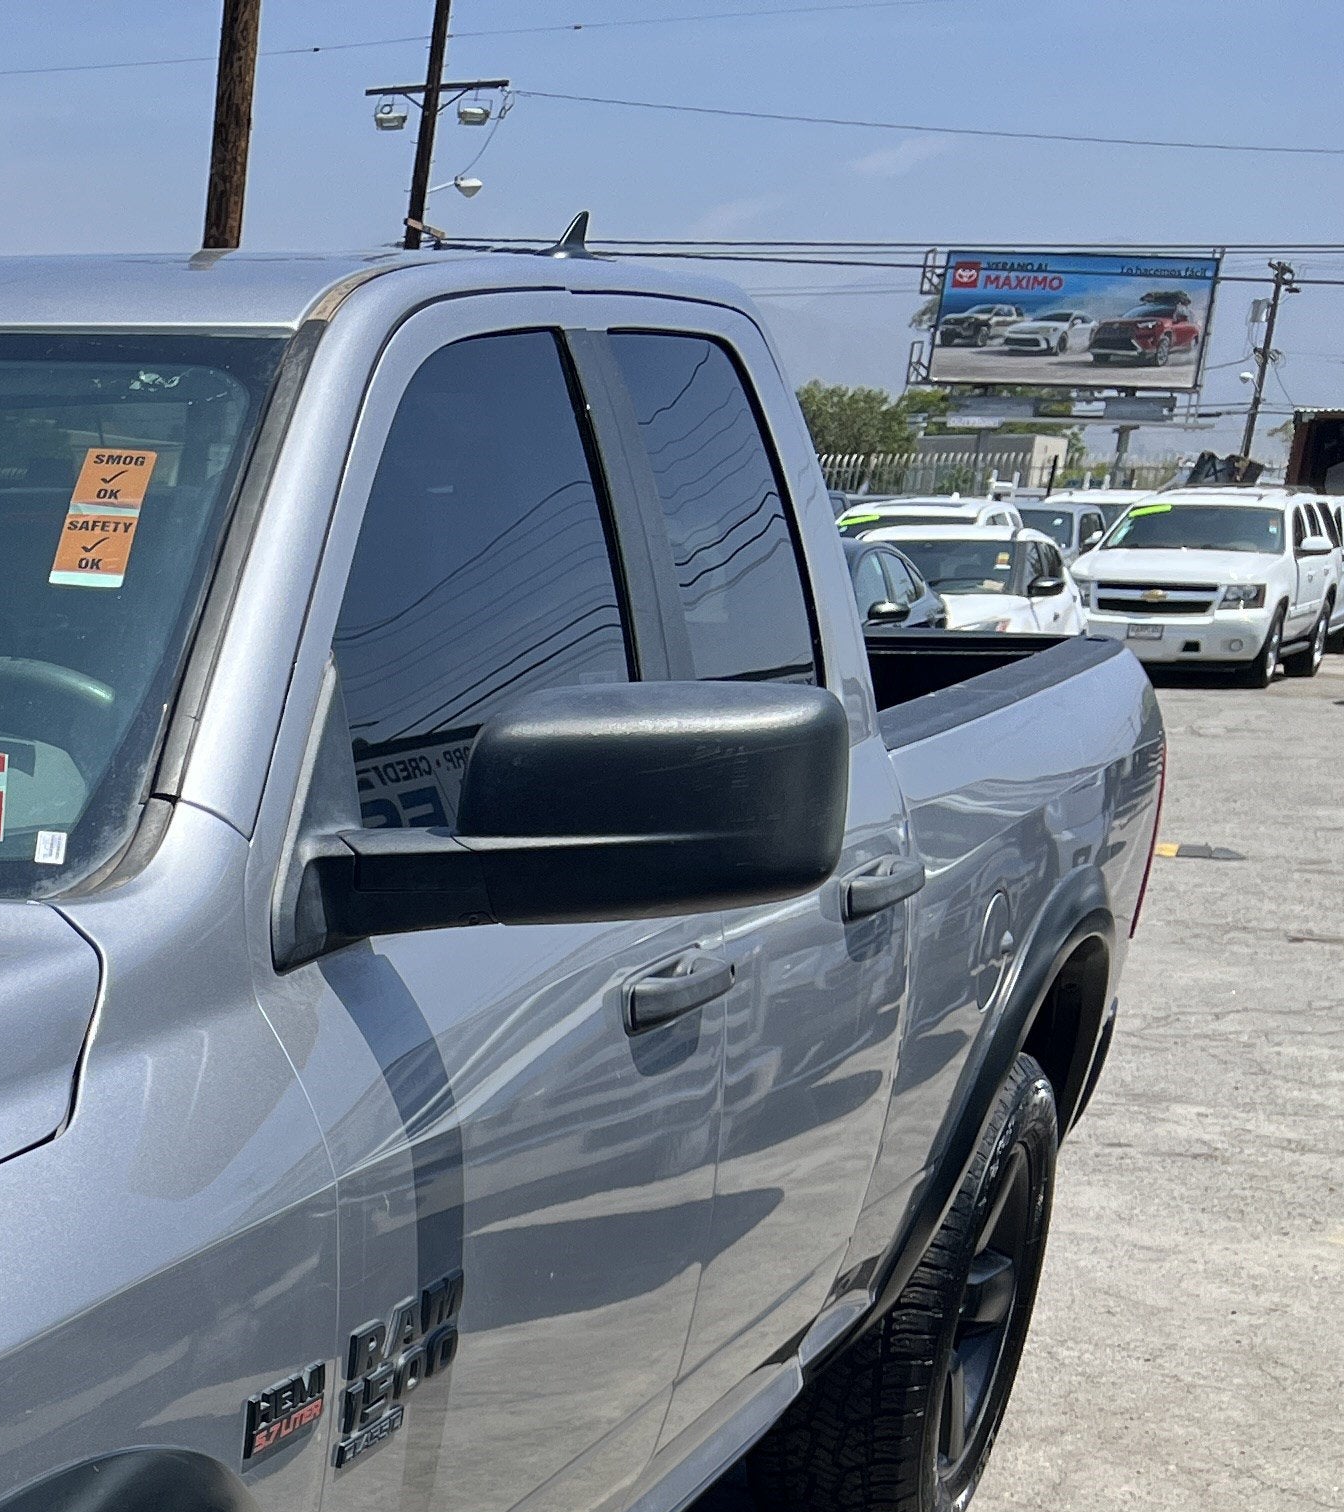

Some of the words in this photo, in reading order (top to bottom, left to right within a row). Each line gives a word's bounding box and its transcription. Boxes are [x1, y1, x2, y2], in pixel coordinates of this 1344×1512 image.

[93, 453, 146, 467] SMOG
[96, 488, 121, 500] OK
[67, 520, 133, 534] SAFETY
[77, 557, 103, 570] OK
[343, 1266, 464, 1381] RAM
[341, 1318, 460, 1436] 1500
[246, 1360, 325, 1432] HEMI
[279, 1398, 323, 1438] LITER
